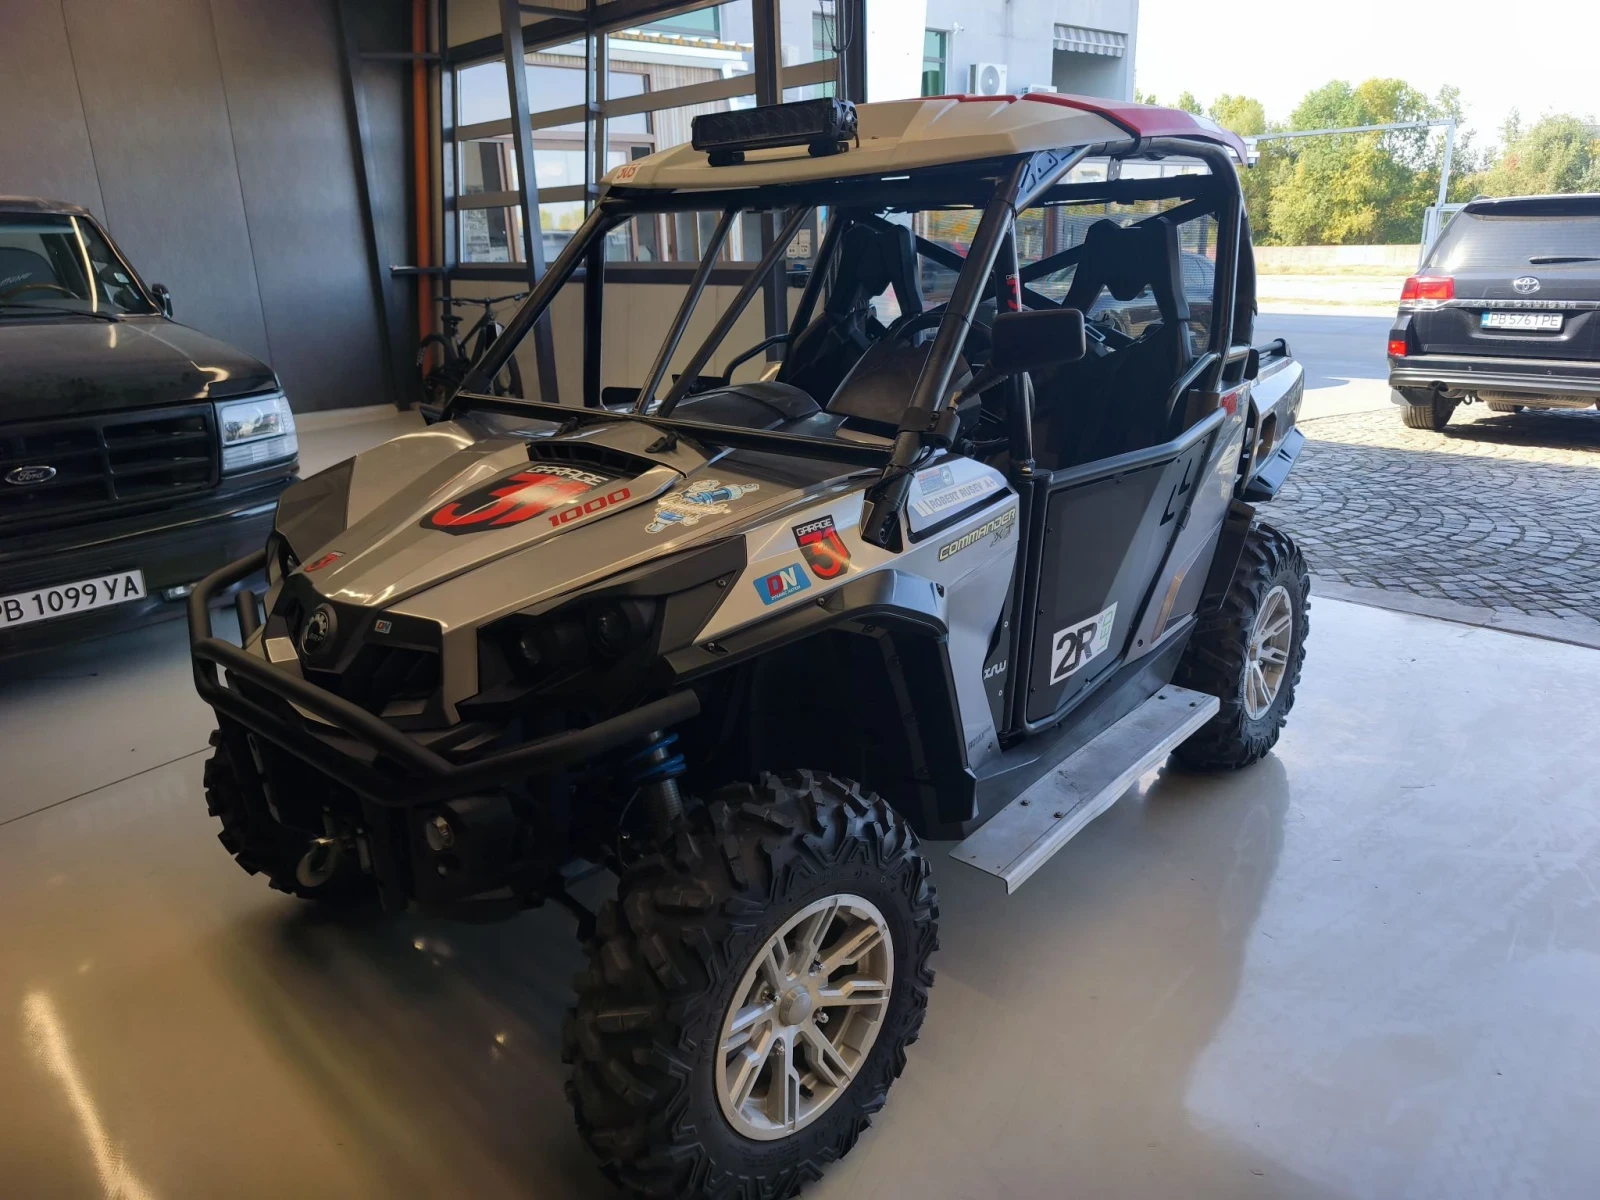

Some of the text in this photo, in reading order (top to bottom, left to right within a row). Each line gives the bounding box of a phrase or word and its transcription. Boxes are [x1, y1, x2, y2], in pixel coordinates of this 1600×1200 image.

[1490, 314, 1559, 327] PB 5761 PE
[18, 471, 43, 481] Ford
[526, 465, 609, 487] GARAGE
[548, 487, 631, 528] 1000
[929, 492, 960, 509] ROBERT
[797, 519, 833, 536] GARAGE
[939, 507, 1016, 561] COMMANDER
[32, 584, 97, 615] 1099
[103, 575, 140, 600] YA
[766, 567, 797, 597] DN
[1097, 610, 1113, 652] LED
[1054, 622, 1098, 679] 2R
